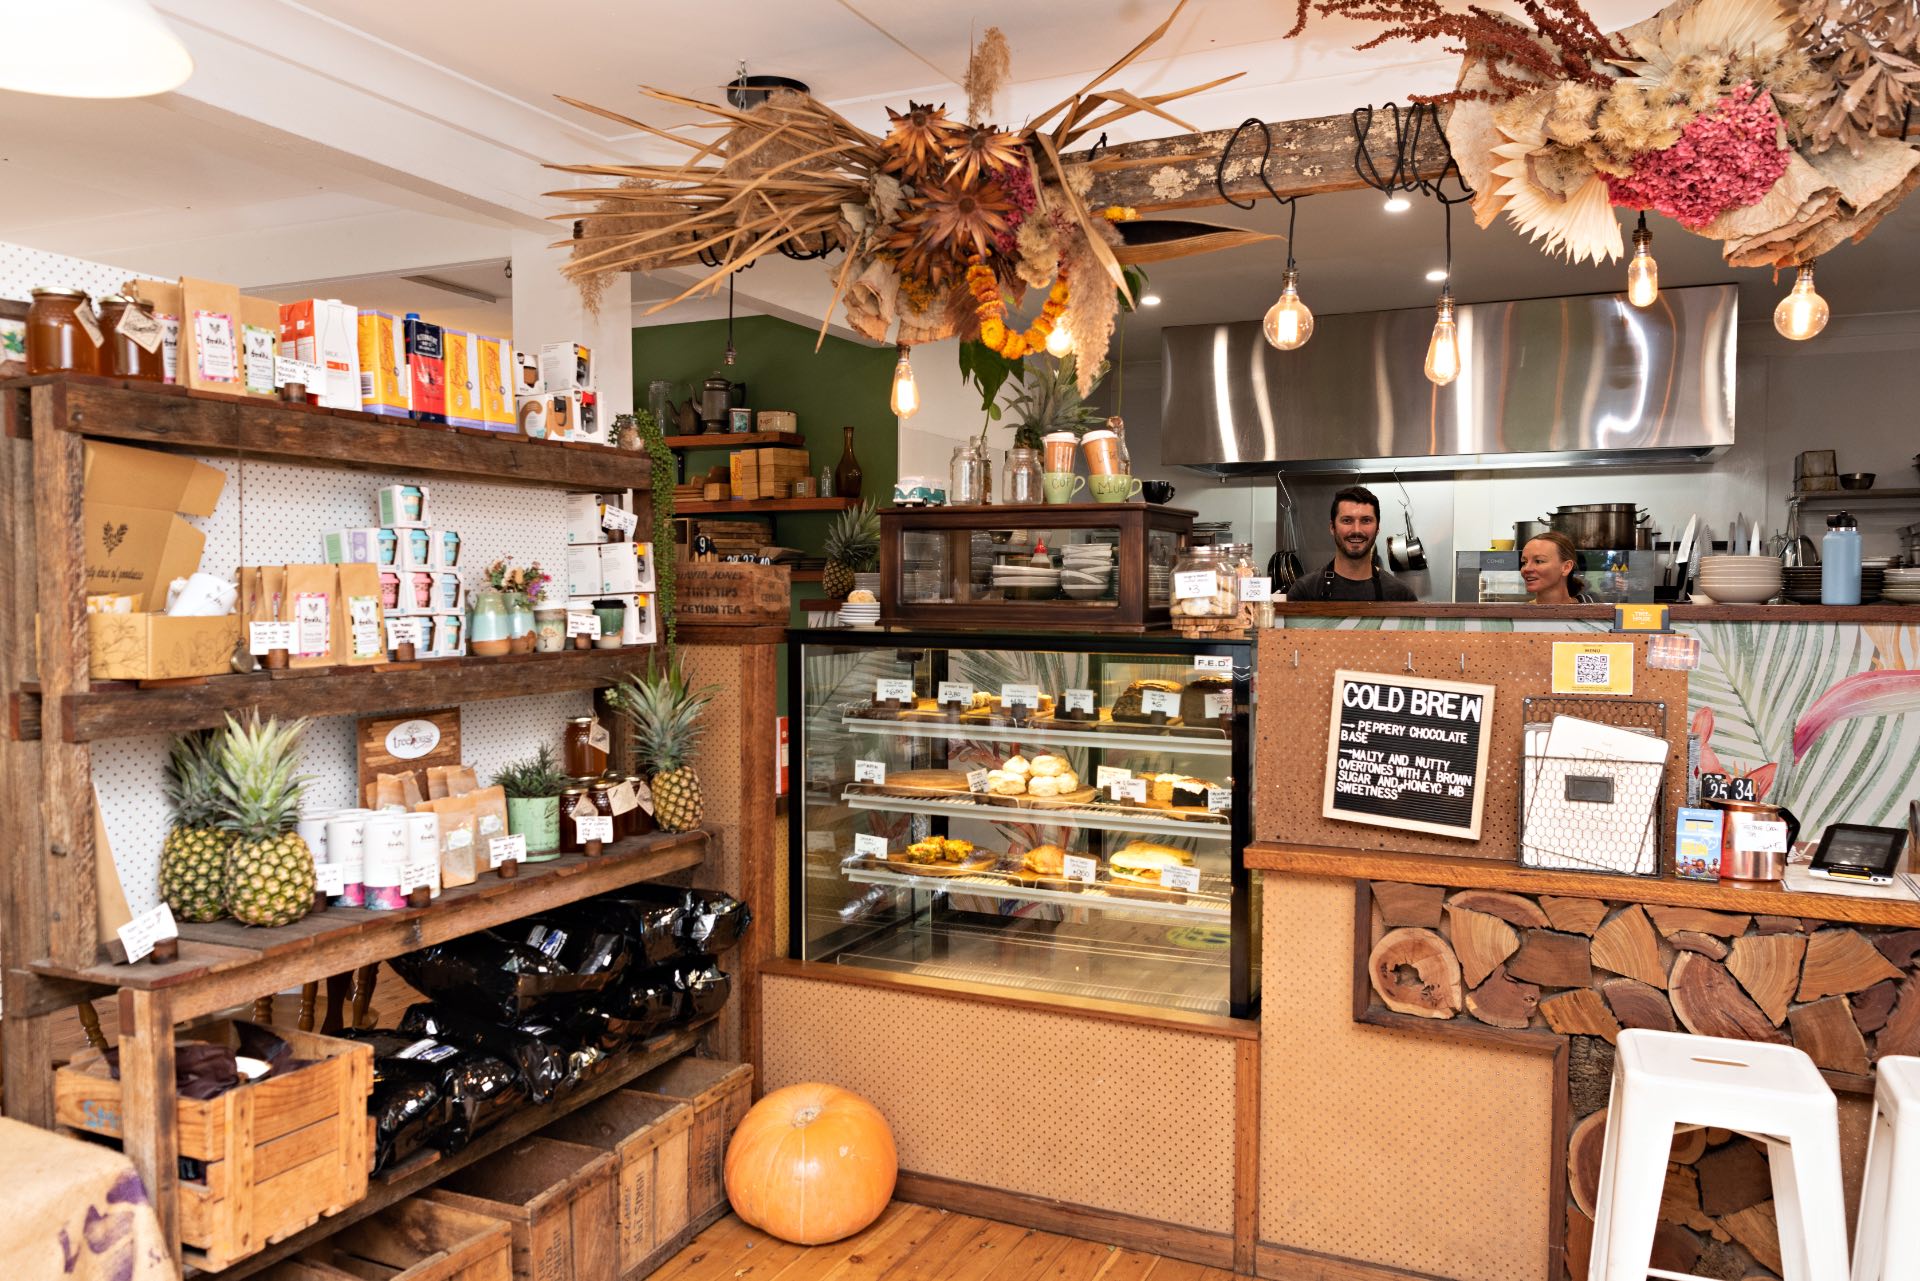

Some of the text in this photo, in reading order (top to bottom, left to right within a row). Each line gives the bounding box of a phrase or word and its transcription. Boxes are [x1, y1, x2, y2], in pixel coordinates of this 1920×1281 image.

[700, 538, 706, 552] 9
[681, 604, 742, 615] CEYLON TEA
[1343, 682, 1482, 722] COLD BREW
[1340, 730, 1368, 744] BASE
[1358, 720, 1468, 744] PEPPERY CHOCOLATE
[1352, 749, 1450, 772] MALTY AND NUTTY
[1338, 759, 1472, 786] OVERTONES WITH A BROWN
[1338, 770, 1371, 785] SUGAR
[1377, 776, 1398, 788] AND
[1336, 782, 1398, 800] SWEETNESS
[1710, 784, 1728, 799] 25
[1735, 780, 1754, 800] 34
